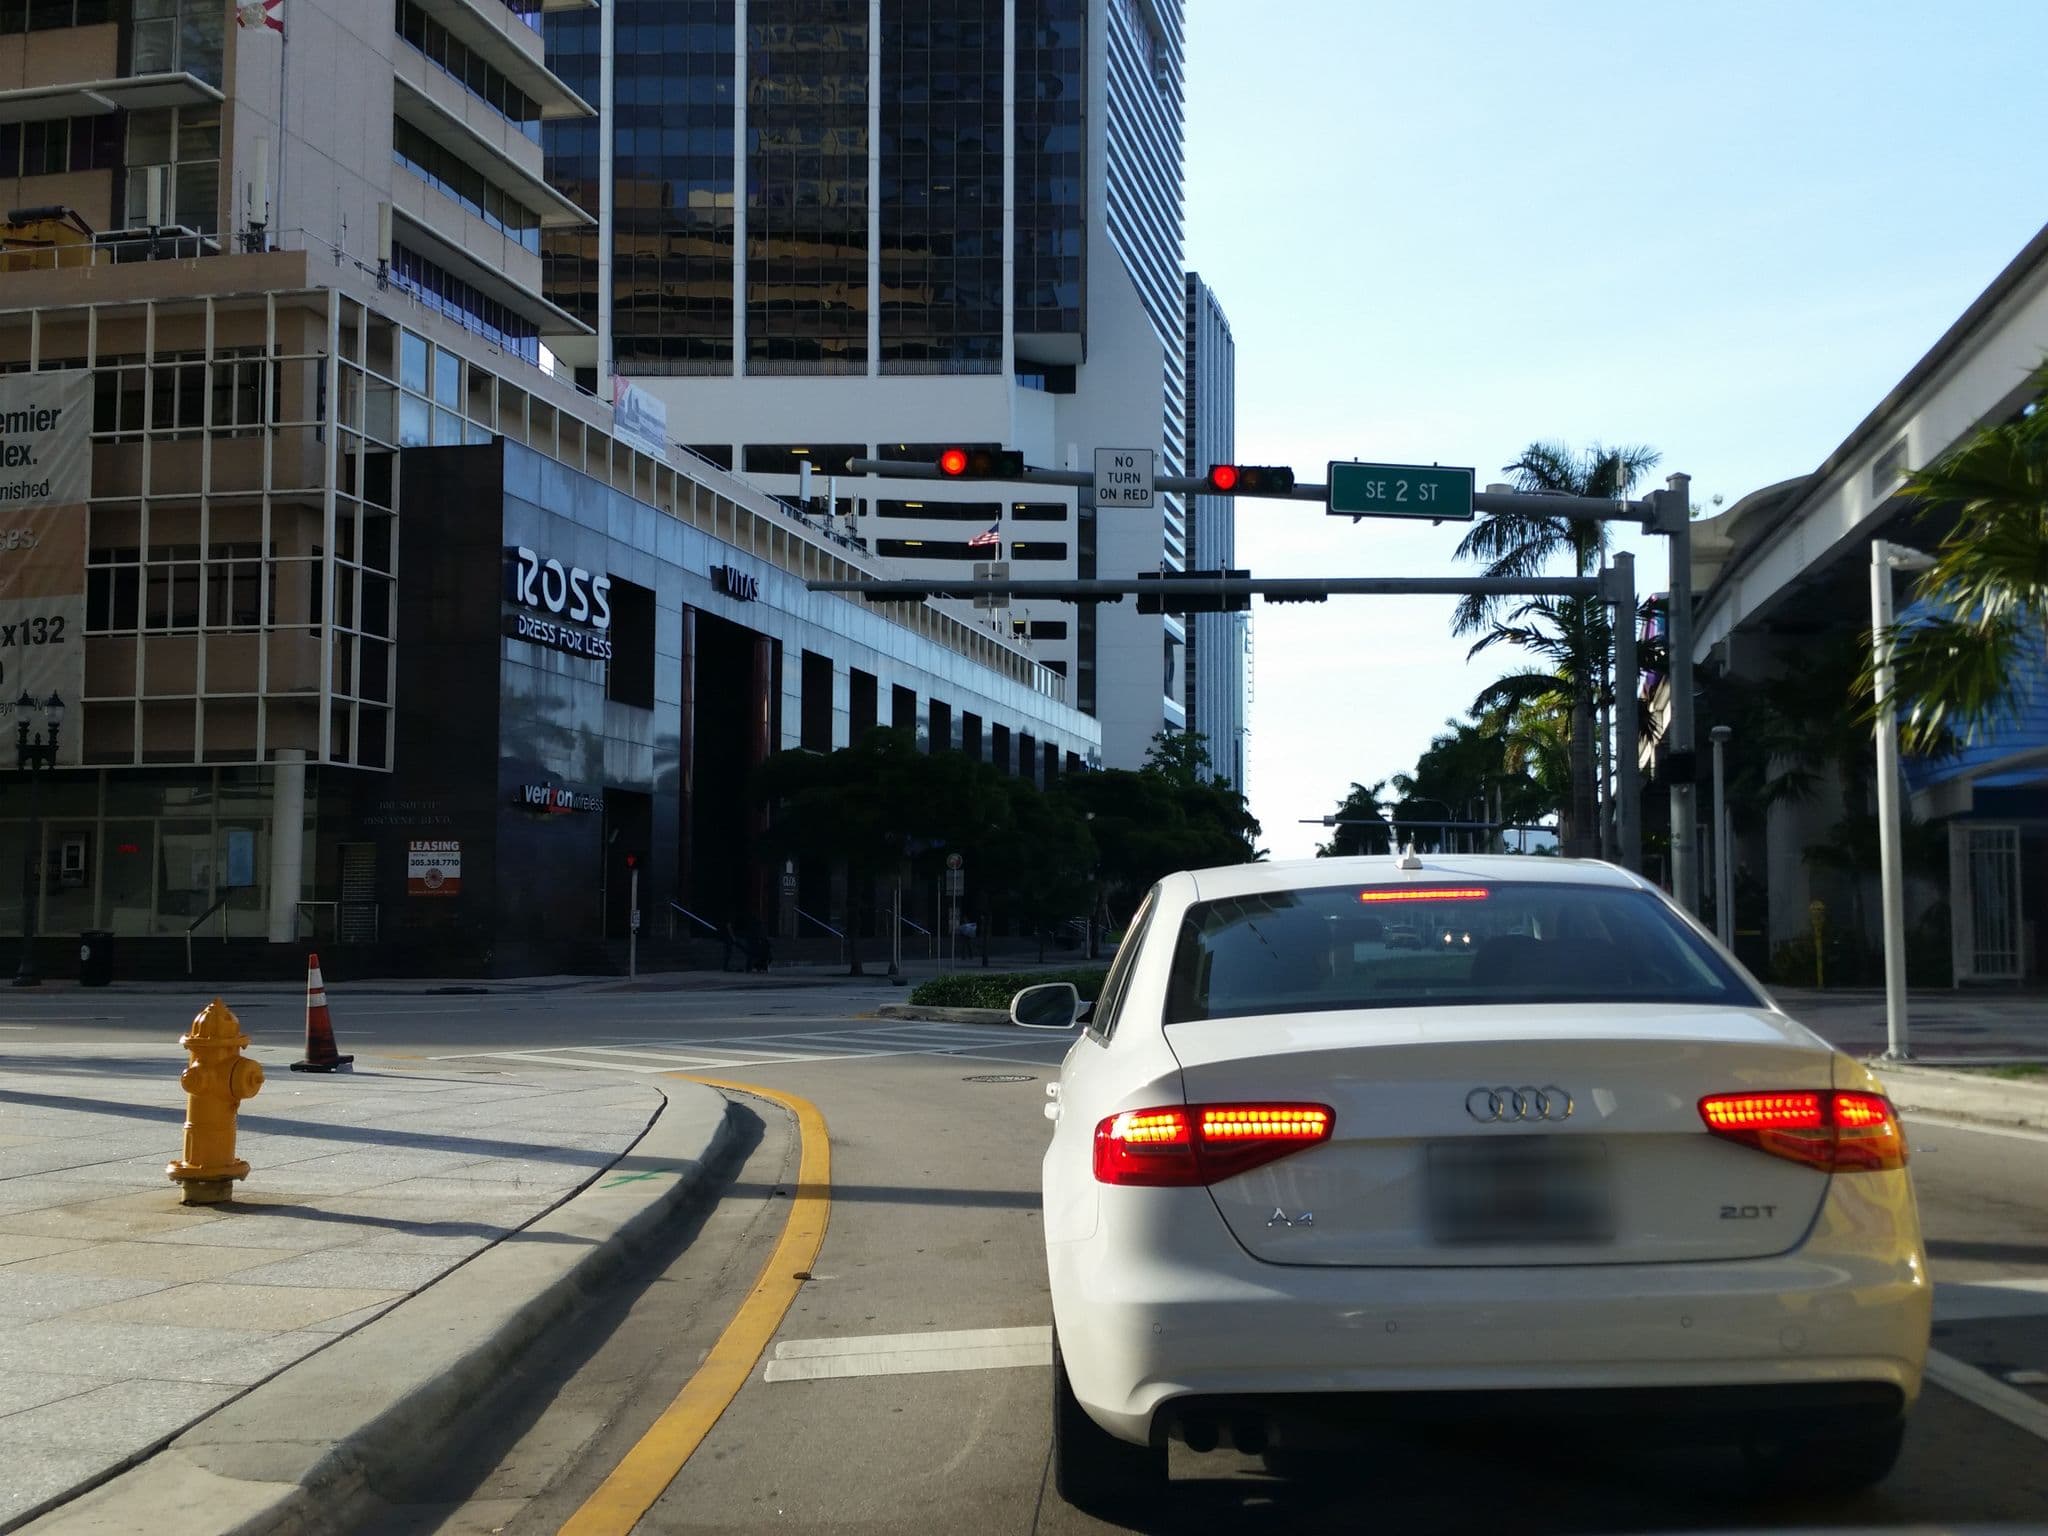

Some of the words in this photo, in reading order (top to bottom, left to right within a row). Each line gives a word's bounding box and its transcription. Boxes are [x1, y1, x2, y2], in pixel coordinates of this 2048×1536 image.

[1114, 456, 1134, 468] NO
[1107, 472, 1142, 484] TURN
[1099, 488, 1117, 500] ON
[1123, 489, 1149, 501] RED
[1365, 480, 1387, 499] SE
[1395, 479, 1408, 502] 2
[1418, 483, 1438, 501] ST
[517, 546, 611, 629] ROSS
[726, 564, 760, 602] VITAS
[518, 615, 556, 644] DRESS
[559, 627, 583, 651] FOR
[585, 634, 613, 659] LESS
[525, 781, 575, 813] verizon
[410, 841, 460, 851] LEASING
[1267, 1206, 1314, 1227] A4
